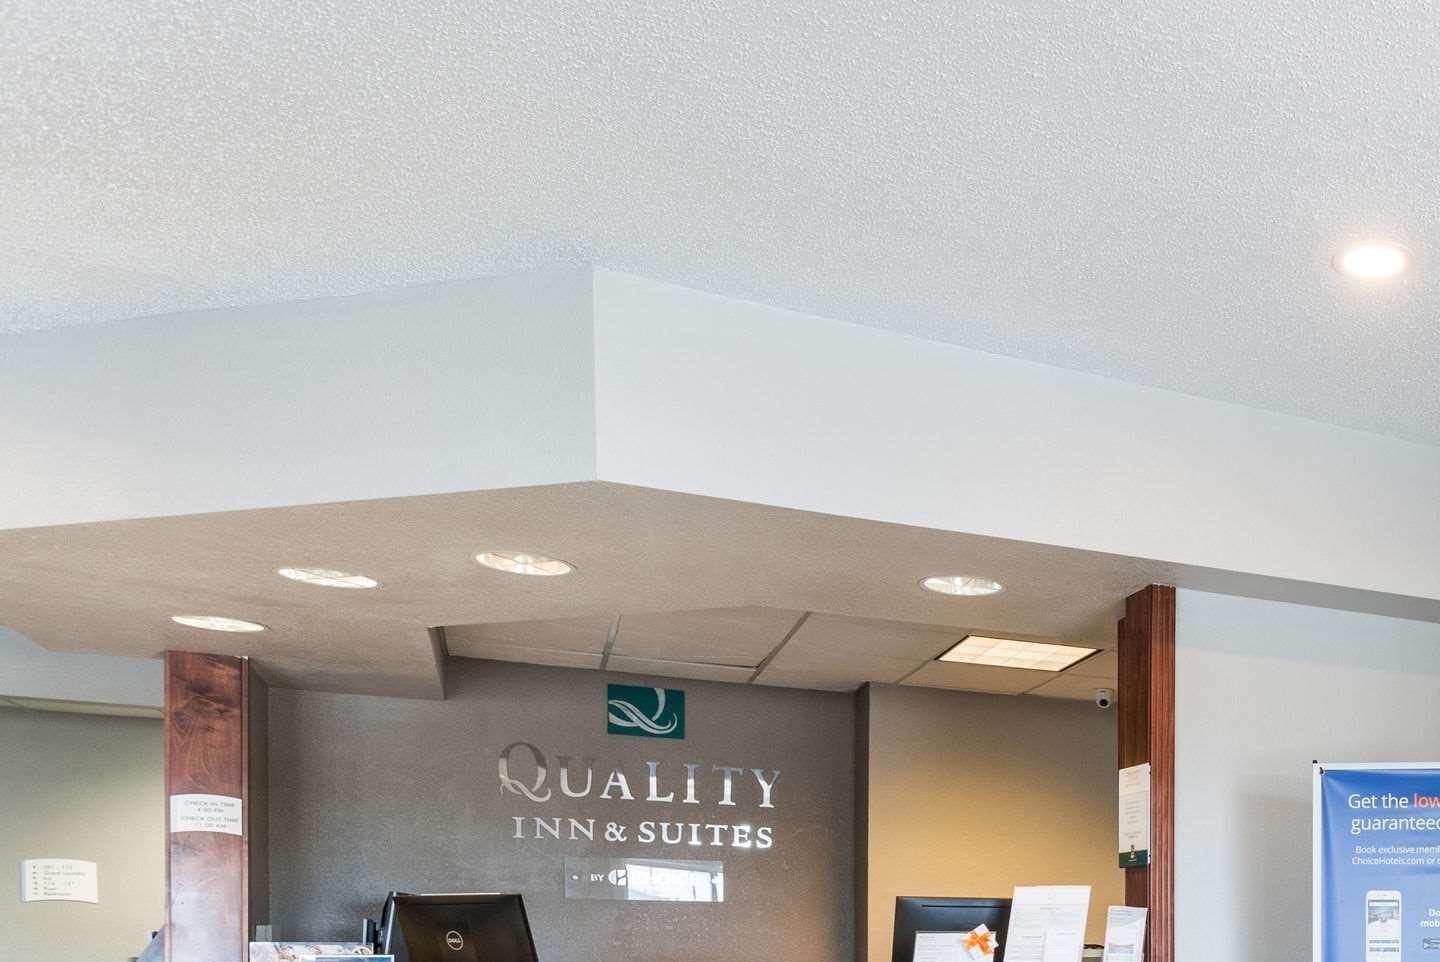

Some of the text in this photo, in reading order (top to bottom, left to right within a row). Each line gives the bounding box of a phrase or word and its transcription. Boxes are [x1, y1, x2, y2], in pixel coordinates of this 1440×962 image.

[499, 742, 780, 808] QUALITY
[1348, 794, 1377, 809] Get
[1382, 793, 1409, 809] the
[512, 816, 773, 848] INN & SUITES
[1355, 845, 1376, 854] Book
[1378, 845, 1416, 854] exclusive
[1351, 856, 1424, 865] ChoiceHotels.com
[1427, 857, 1436, 865] or
[590, 873, 605, 882] BY
